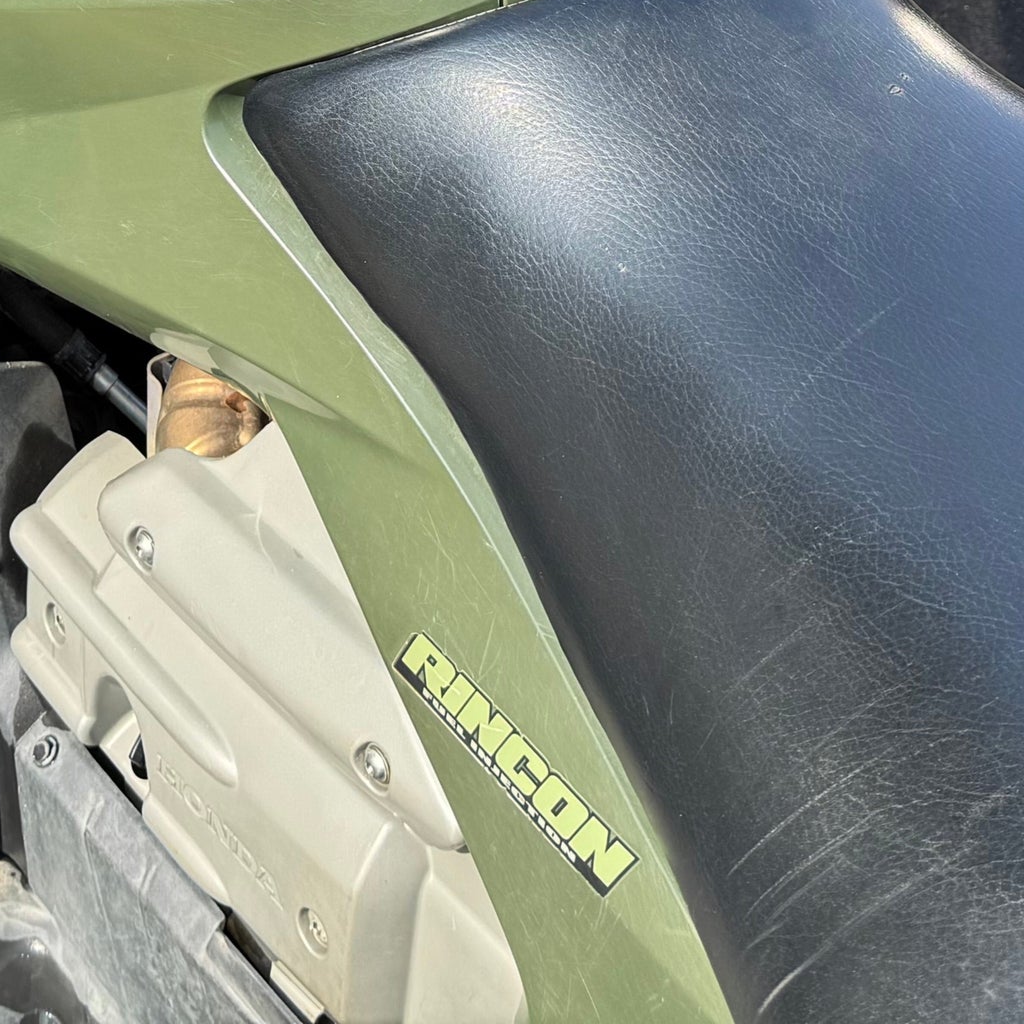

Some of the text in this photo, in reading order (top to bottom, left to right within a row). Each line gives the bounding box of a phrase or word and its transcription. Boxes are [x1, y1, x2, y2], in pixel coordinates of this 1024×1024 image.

[156, 752, 284, 911] HONDA
[398, 632, 640, 890] RINCON
[421, 686, 577, 863] FUEL INJECTION
